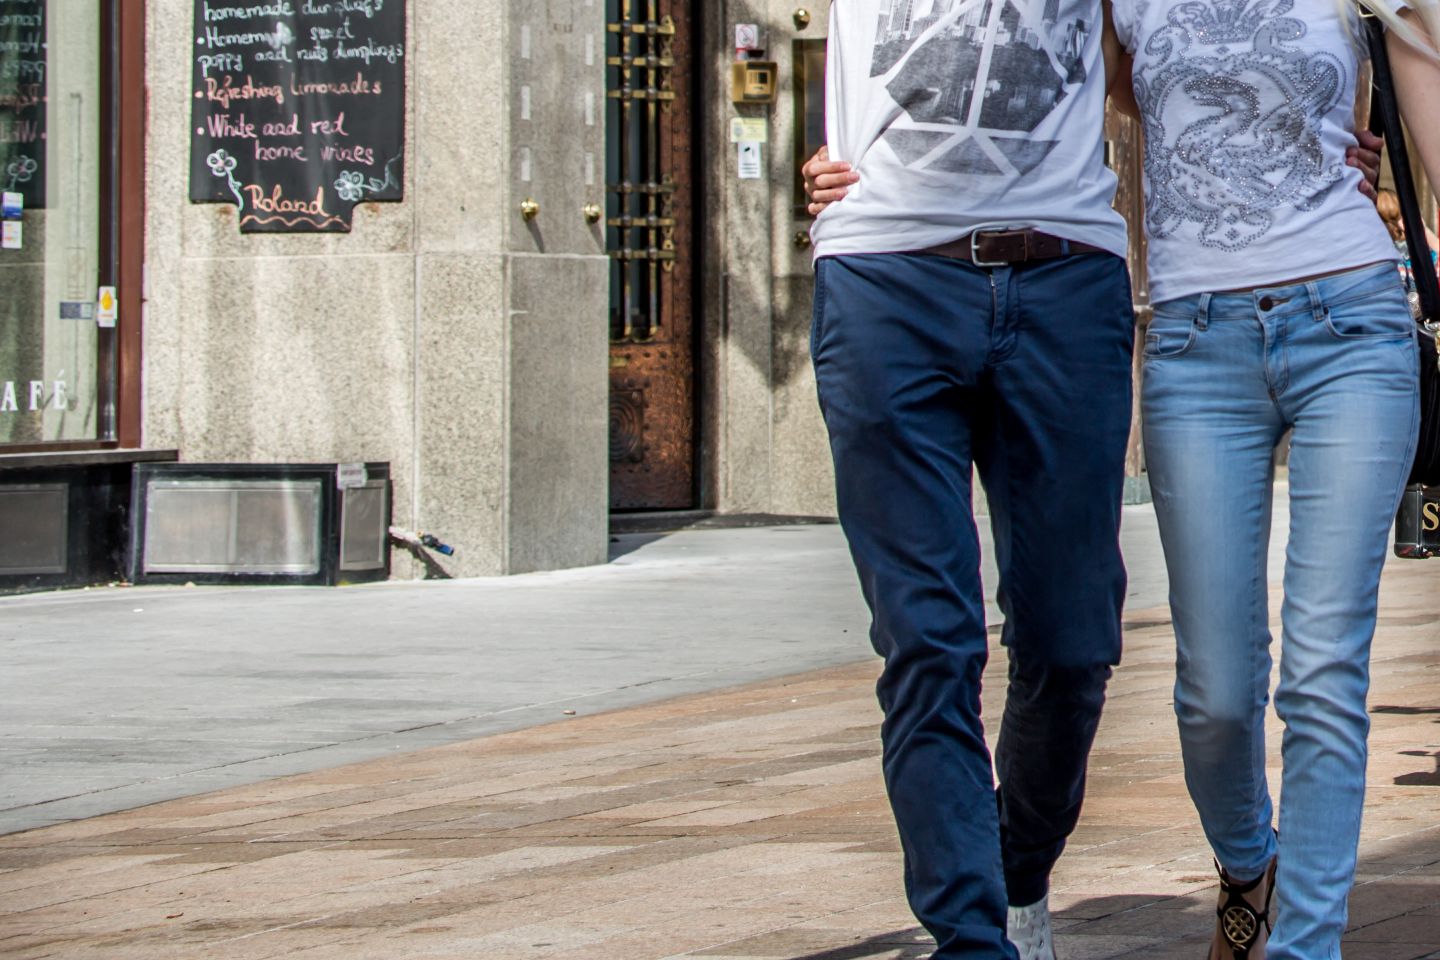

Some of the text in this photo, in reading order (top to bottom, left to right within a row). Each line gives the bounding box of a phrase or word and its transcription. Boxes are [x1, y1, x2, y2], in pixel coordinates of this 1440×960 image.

[197, 52, 243, 78] poppy
[254, 45, 292, 63] and
[332, 38, 404, 64] dumplings
[206, 75, 284, 109] Refreshing
[207, 111, 349, 138] White and red
[254, 139, 374, 165] home wines
[243, 183, 331, 217] Roland
